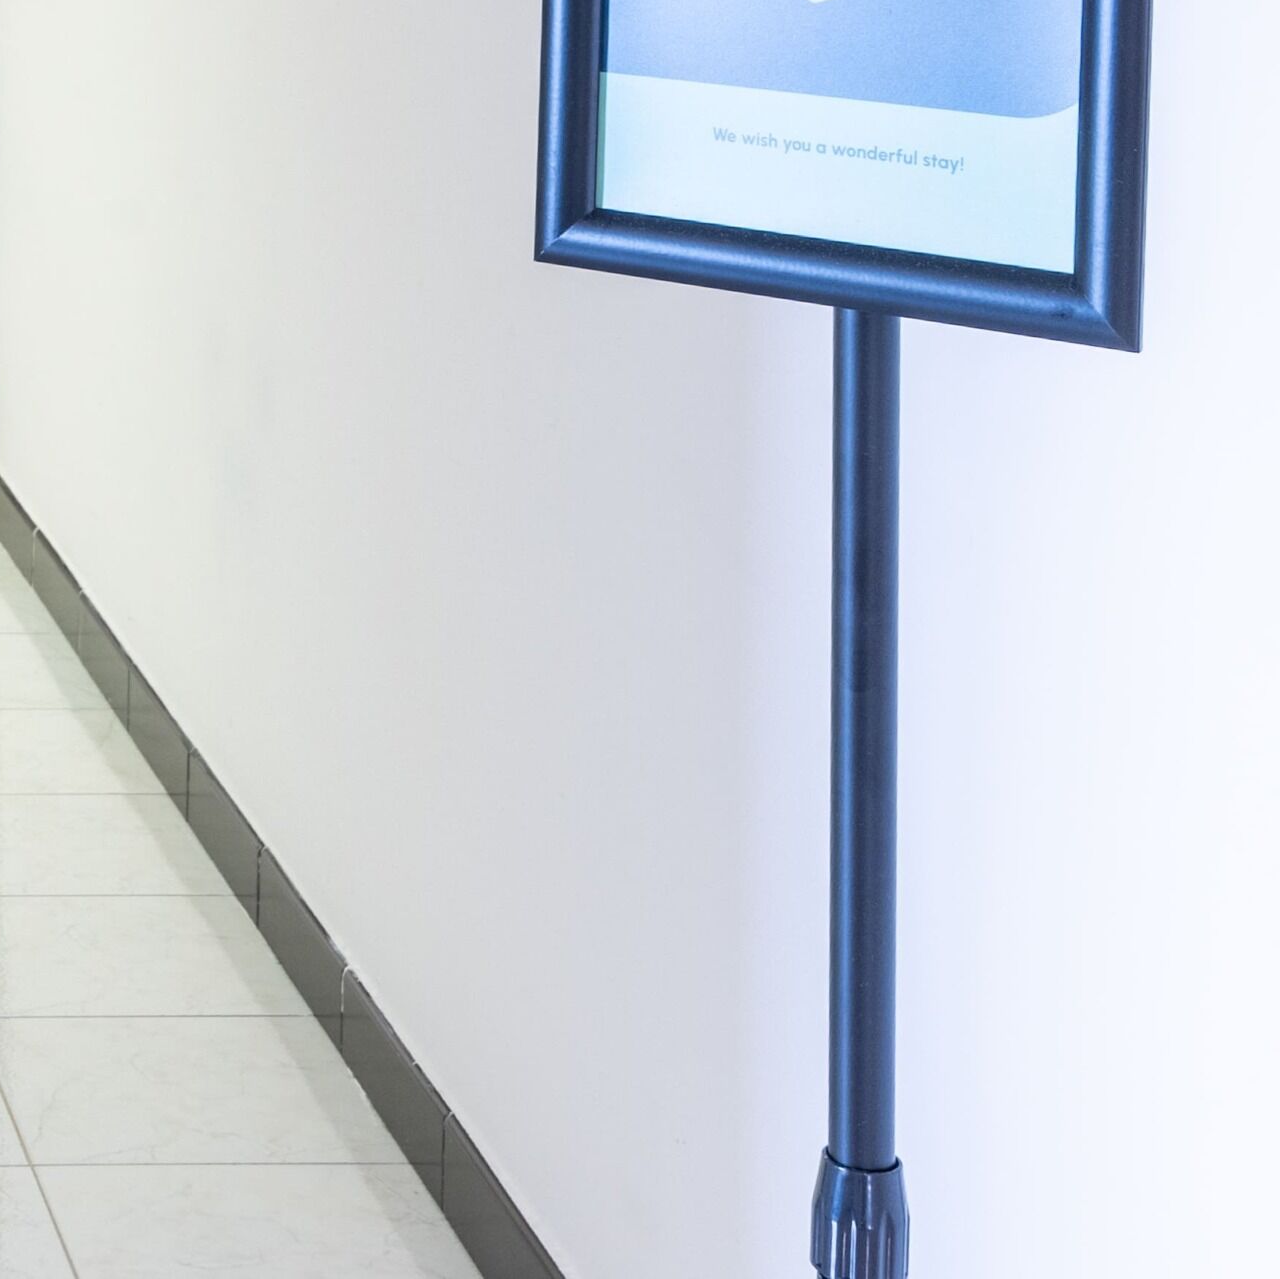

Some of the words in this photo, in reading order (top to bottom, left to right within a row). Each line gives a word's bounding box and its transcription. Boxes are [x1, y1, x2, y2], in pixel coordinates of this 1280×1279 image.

[712, 126, 737, 143] We
[741, 131, 778, 149] wish
[783, 137, 811, 155] you
[815, 143, 827, 155] a
[831, 143, 918, 166] wonderful
[922, 153, 965, 175] stay!
